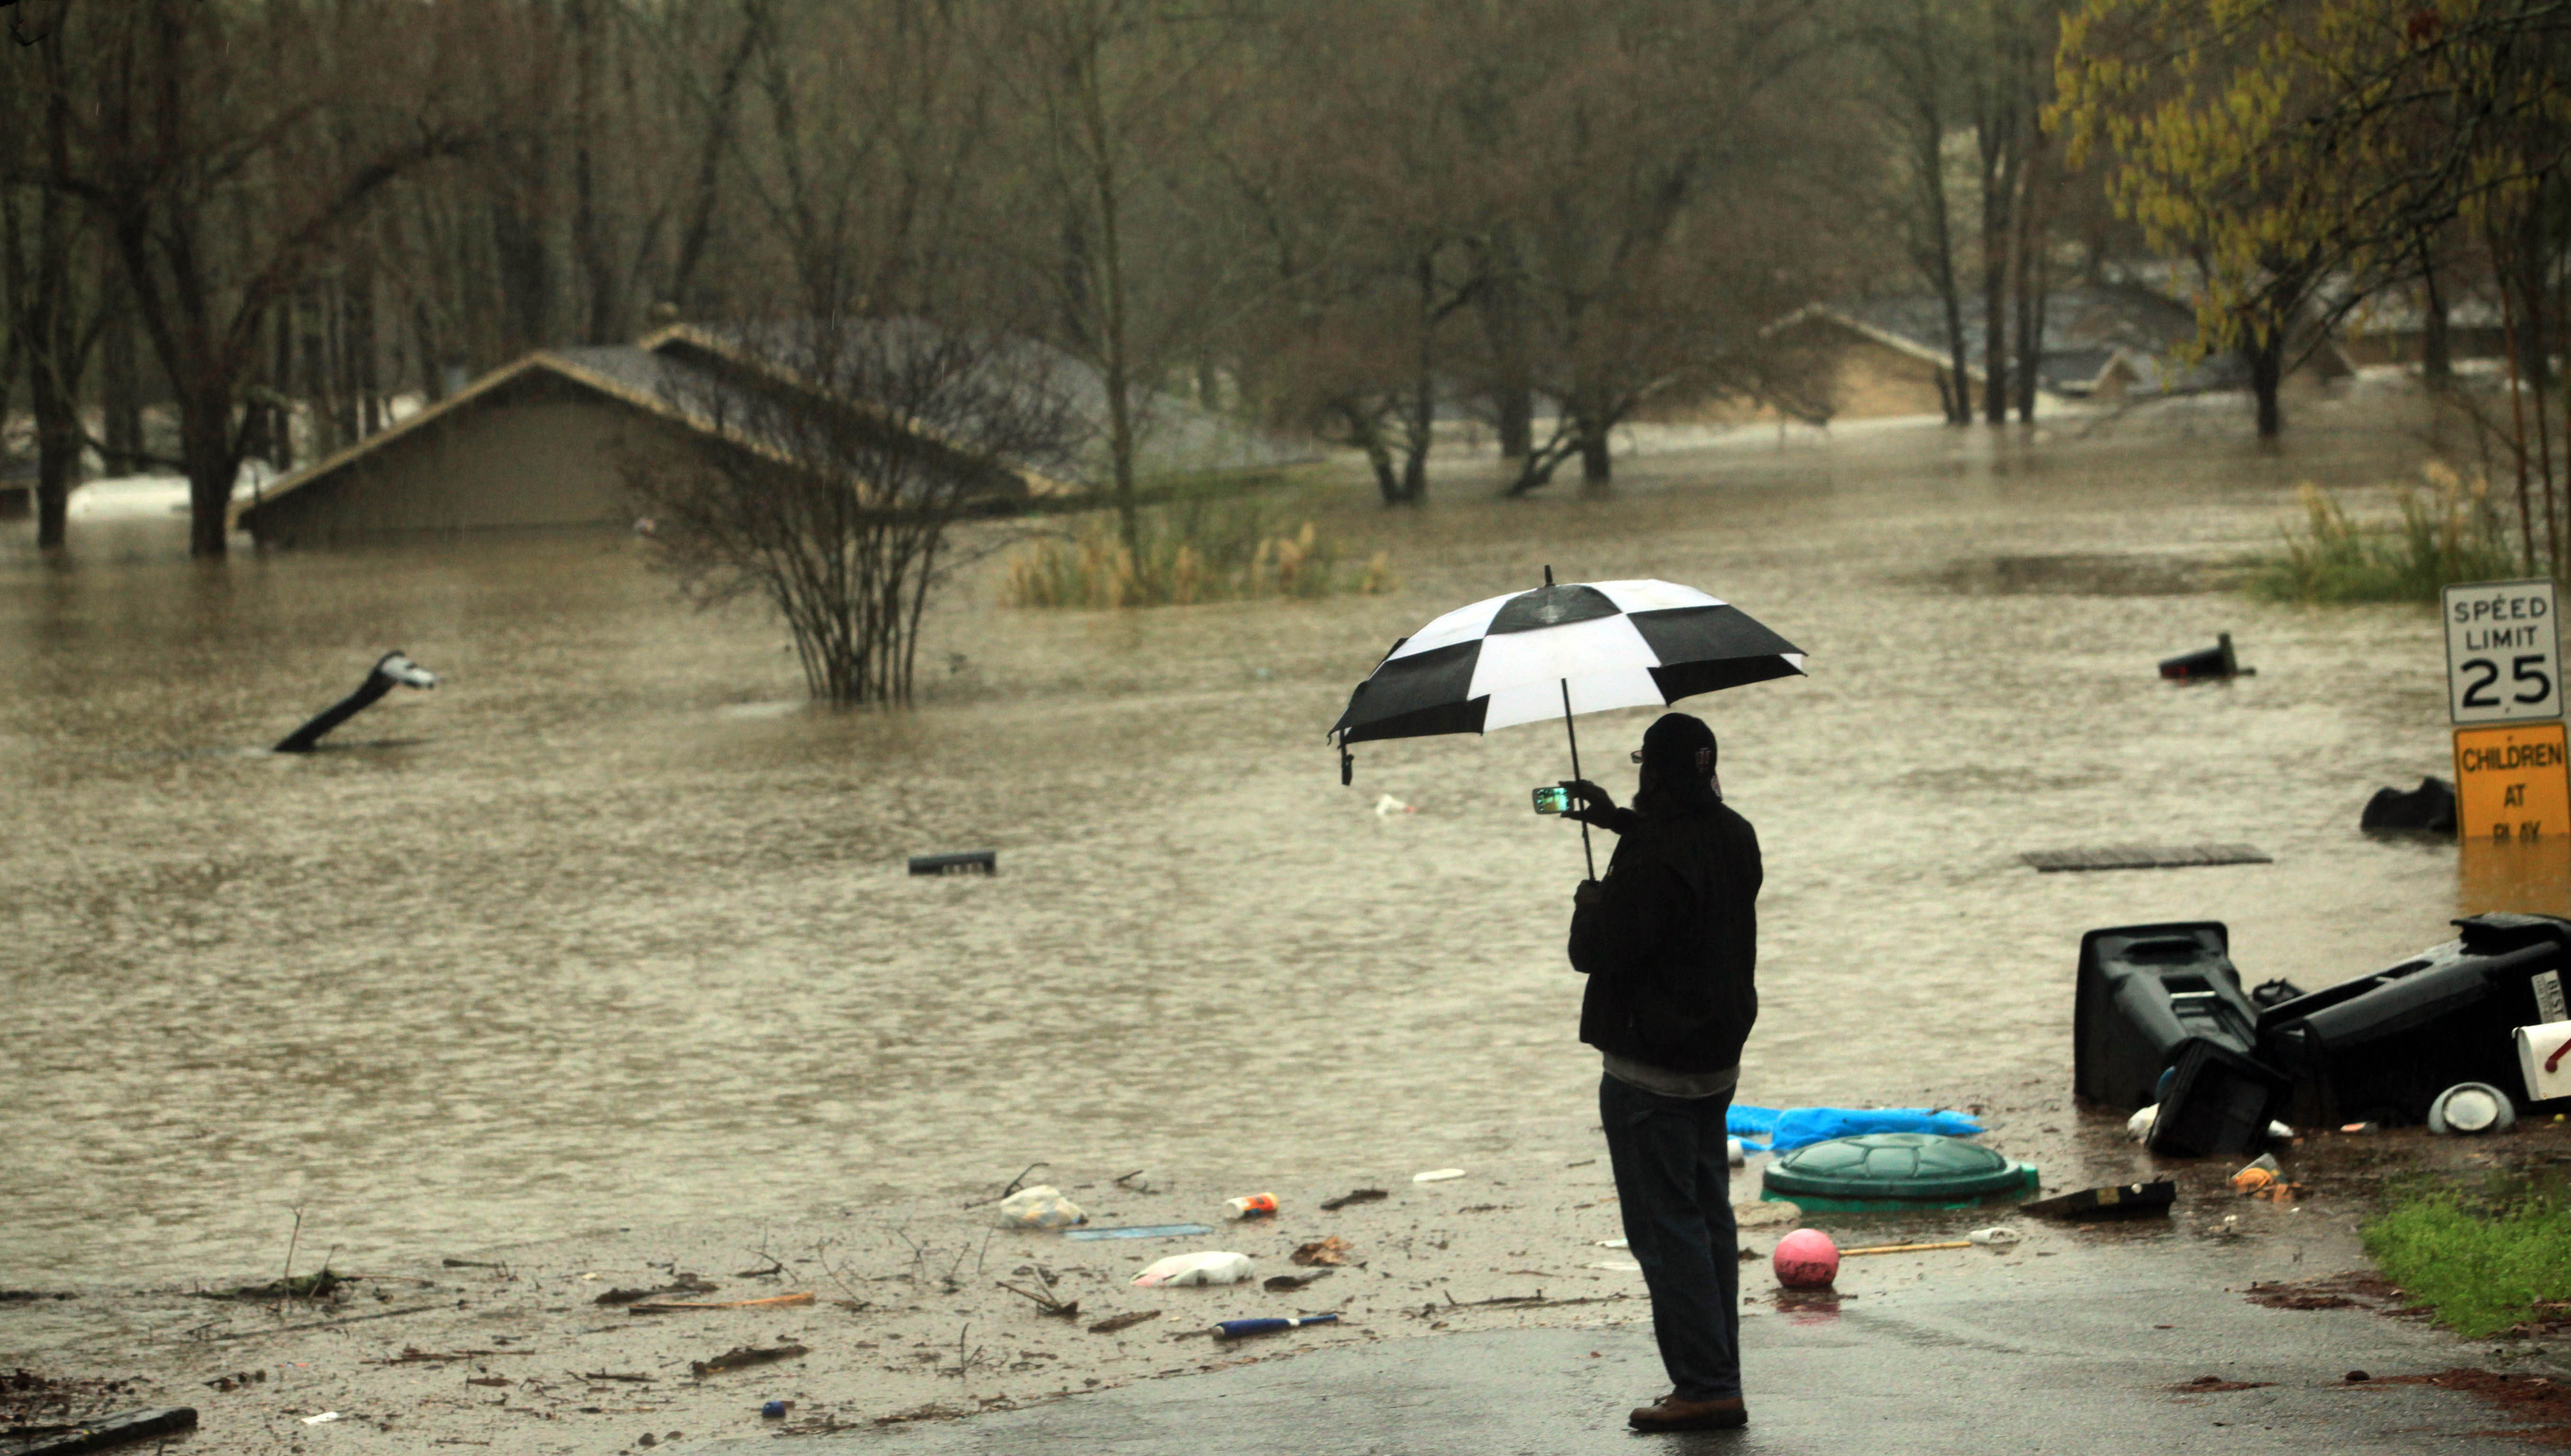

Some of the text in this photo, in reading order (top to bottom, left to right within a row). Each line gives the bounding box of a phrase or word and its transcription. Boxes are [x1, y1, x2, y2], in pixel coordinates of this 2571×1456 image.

[2454, 596, 2548, 623] SPEED
[2466, 625, 2537, 650] LIMIT
[2461, 654, 2551, 708] 25
[2463, 743, 2562, 772] CHILDREN
[2504, 783, 2526, 807] AT
